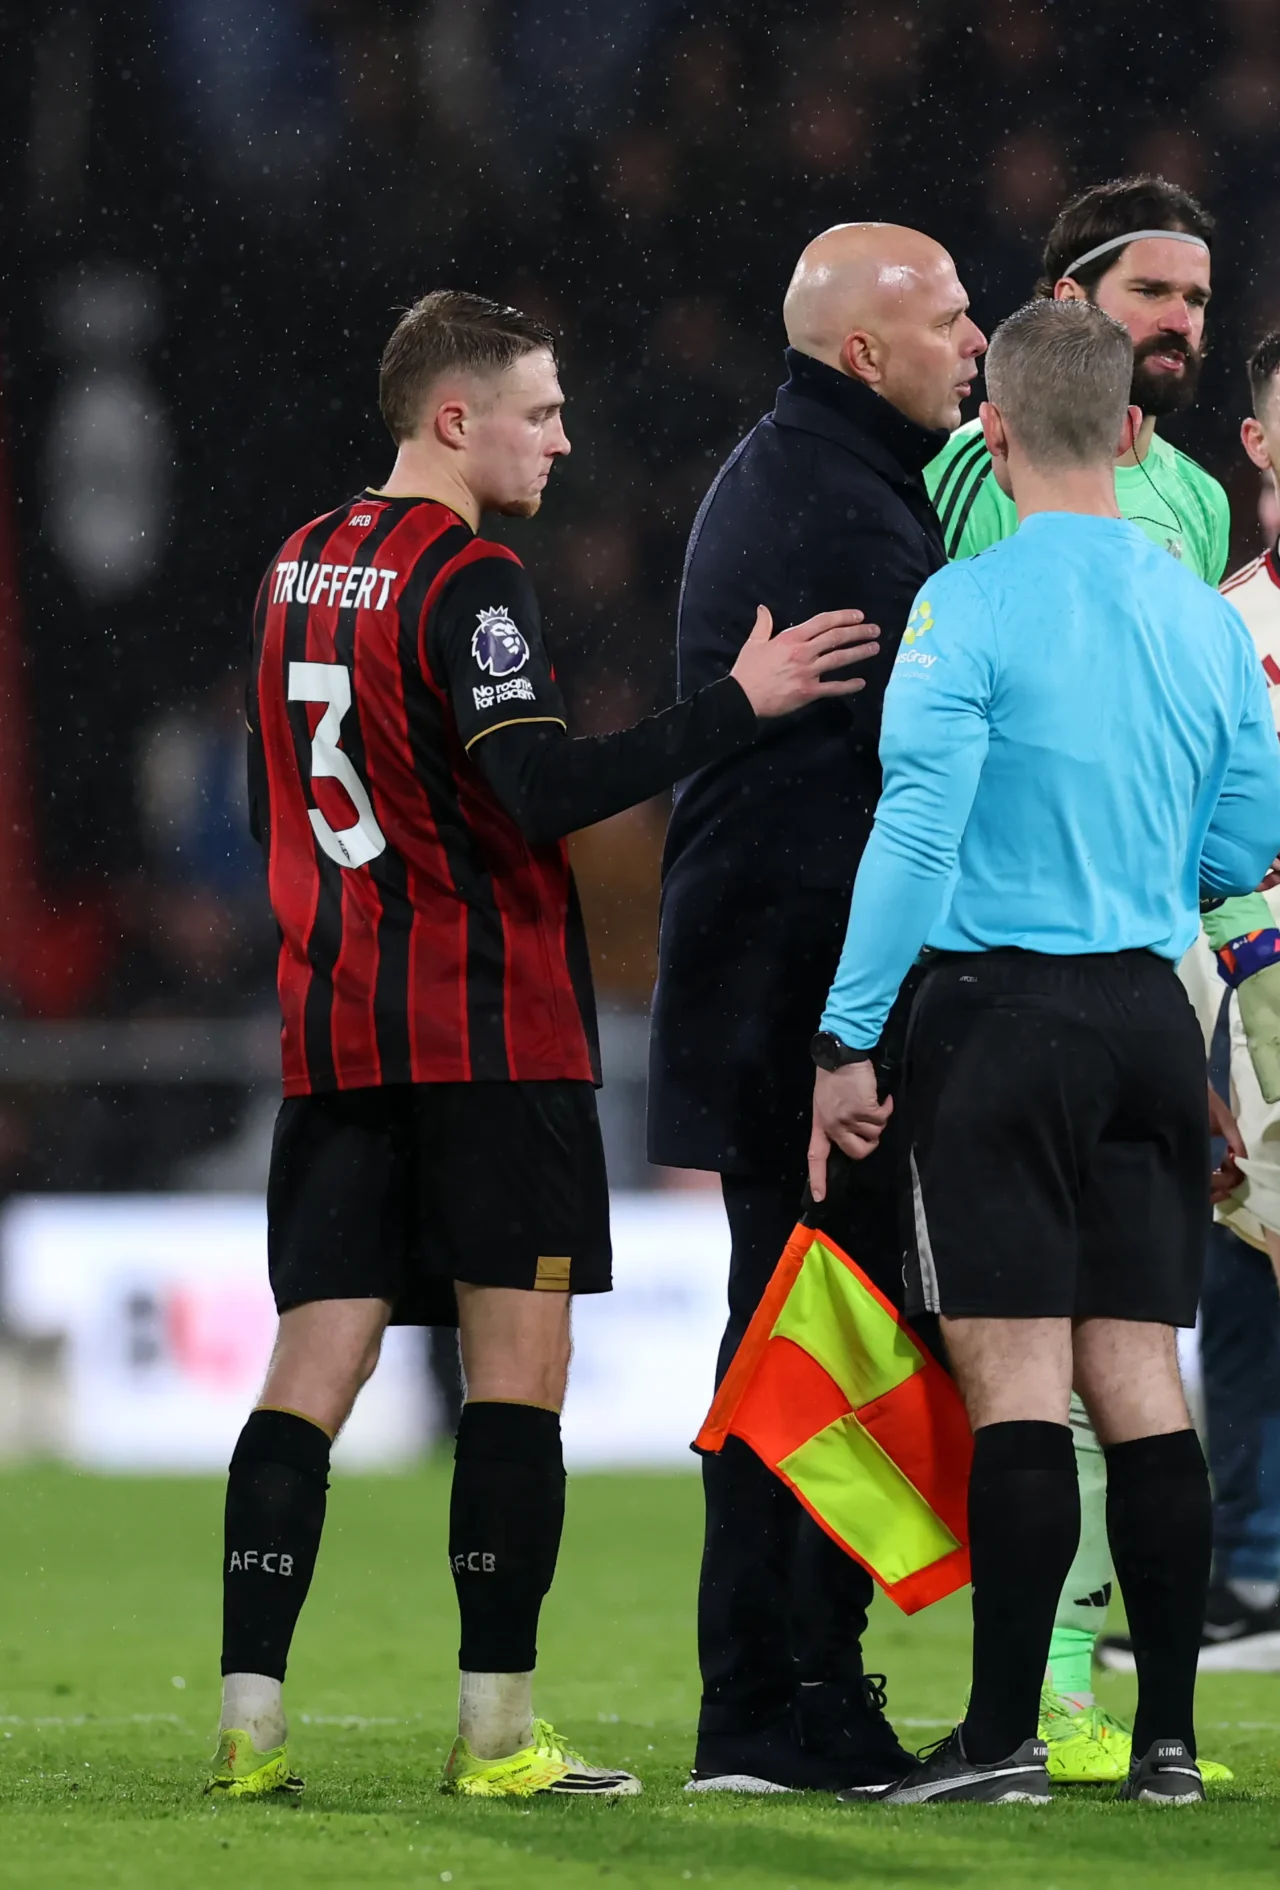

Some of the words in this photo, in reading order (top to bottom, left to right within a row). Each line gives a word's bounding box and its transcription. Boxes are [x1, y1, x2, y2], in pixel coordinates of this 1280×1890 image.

[348, 514, 372, 527] AFCB
[273, 560, 398, 611] TRUFFERT
[472, 685, 494, 701] No
[473, 696, 495, 711] for
[496, 688, 537, 704] racism
[288, 661, 386, 870] 3
[228, 1550, 294, 1577] AFCB
[1032, 1746, 1048, 1757] KIN
[1158, 1746, 1183, 1758] KING
